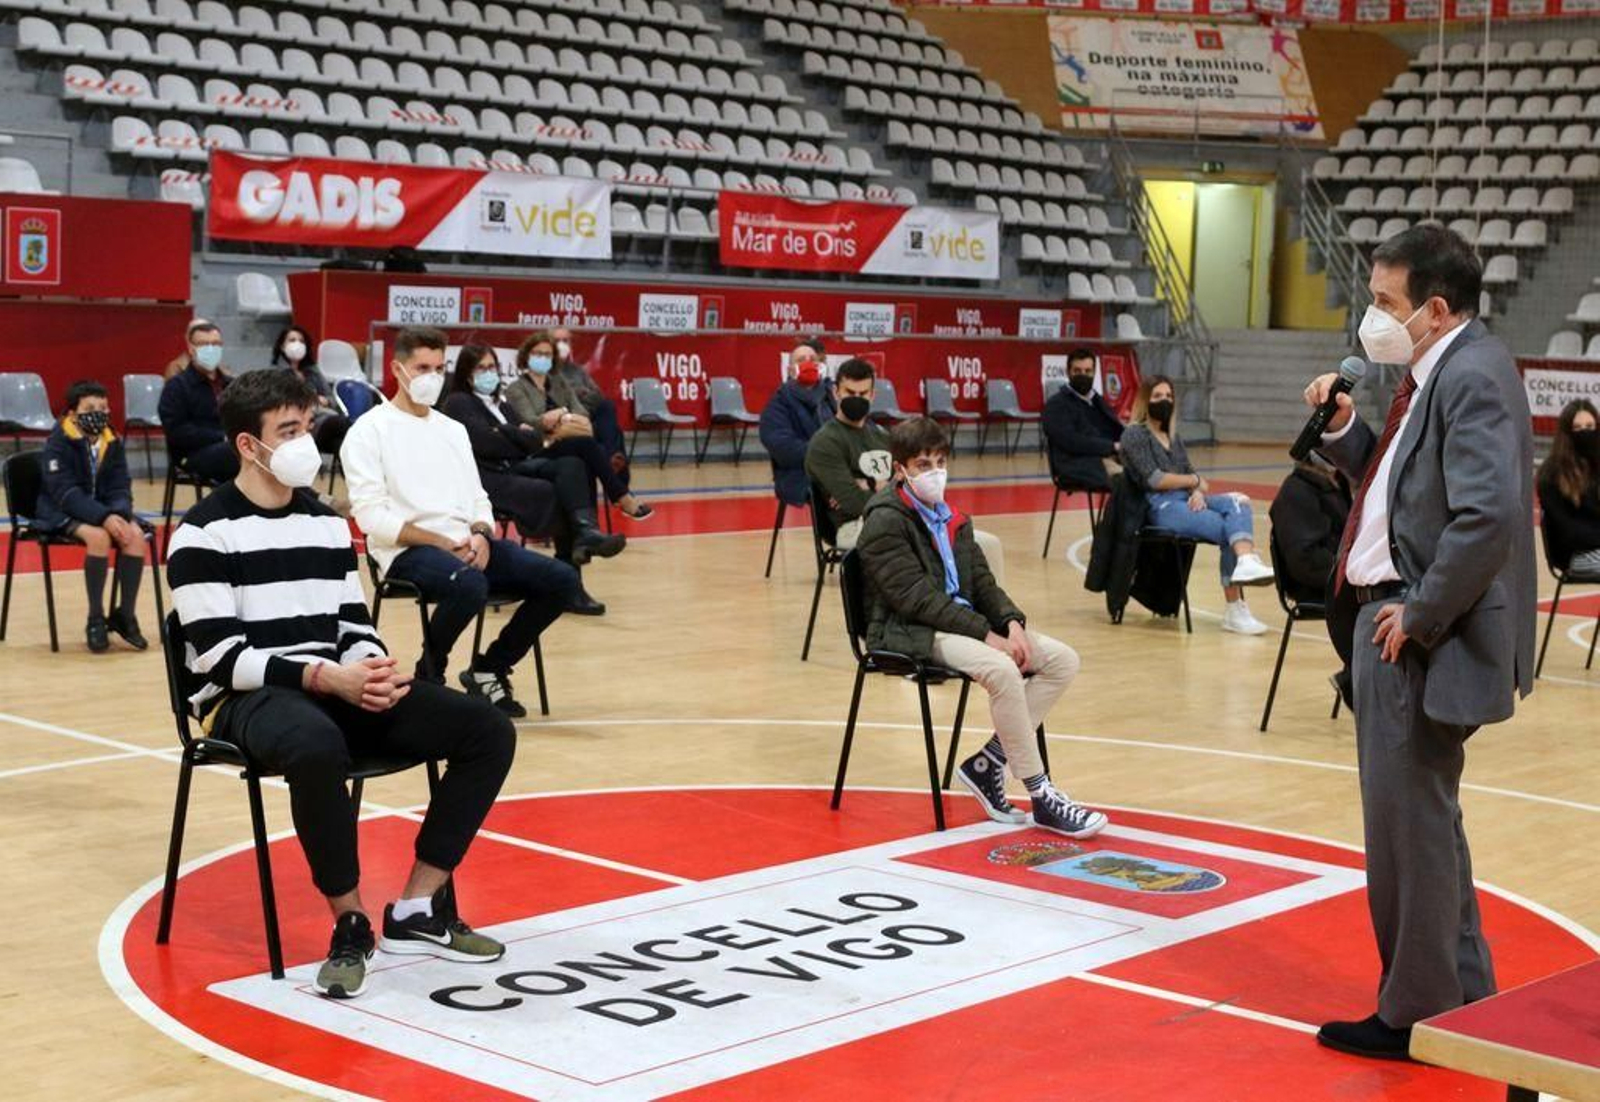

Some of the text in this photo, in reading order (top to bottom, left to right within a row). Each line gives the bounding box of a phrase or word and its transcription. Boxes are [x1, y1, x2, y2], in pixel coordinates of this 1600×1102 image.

[1088, 51, 1271, 74] Deporte feminino,
[1127, 69, 1238, 84] na máxima
[237, 169, 406, 231] GADIS
[732, 224, 857, 258] Mar de Ons
[394, 295, 455, 309] CONCELLO
[549, 292, 588, 315] VIGO,
[643, 302, 694, 315] CONCELLO
[770, 301, 802, 322] VIGO,
[400, 310, 448, 323] DE VIGO
[563, 311, 580, 327] de
[648, 316, 688, 328] DE VIGO
[848, 310, 891, 322] CONCELLO
[956, 307, 984, 327] VIGO,
[656, 352, 707, 381] VIGO,
[947, 355, 986, 382] VIGO,
[677, 377, 699, 400] de
[963, 378, 979, 399] de
[1535, 393, 1553, 407] DE
[428, 891, 919, 1012] CONCELLO
[576, 923, 966, 1027] DE VIGO
